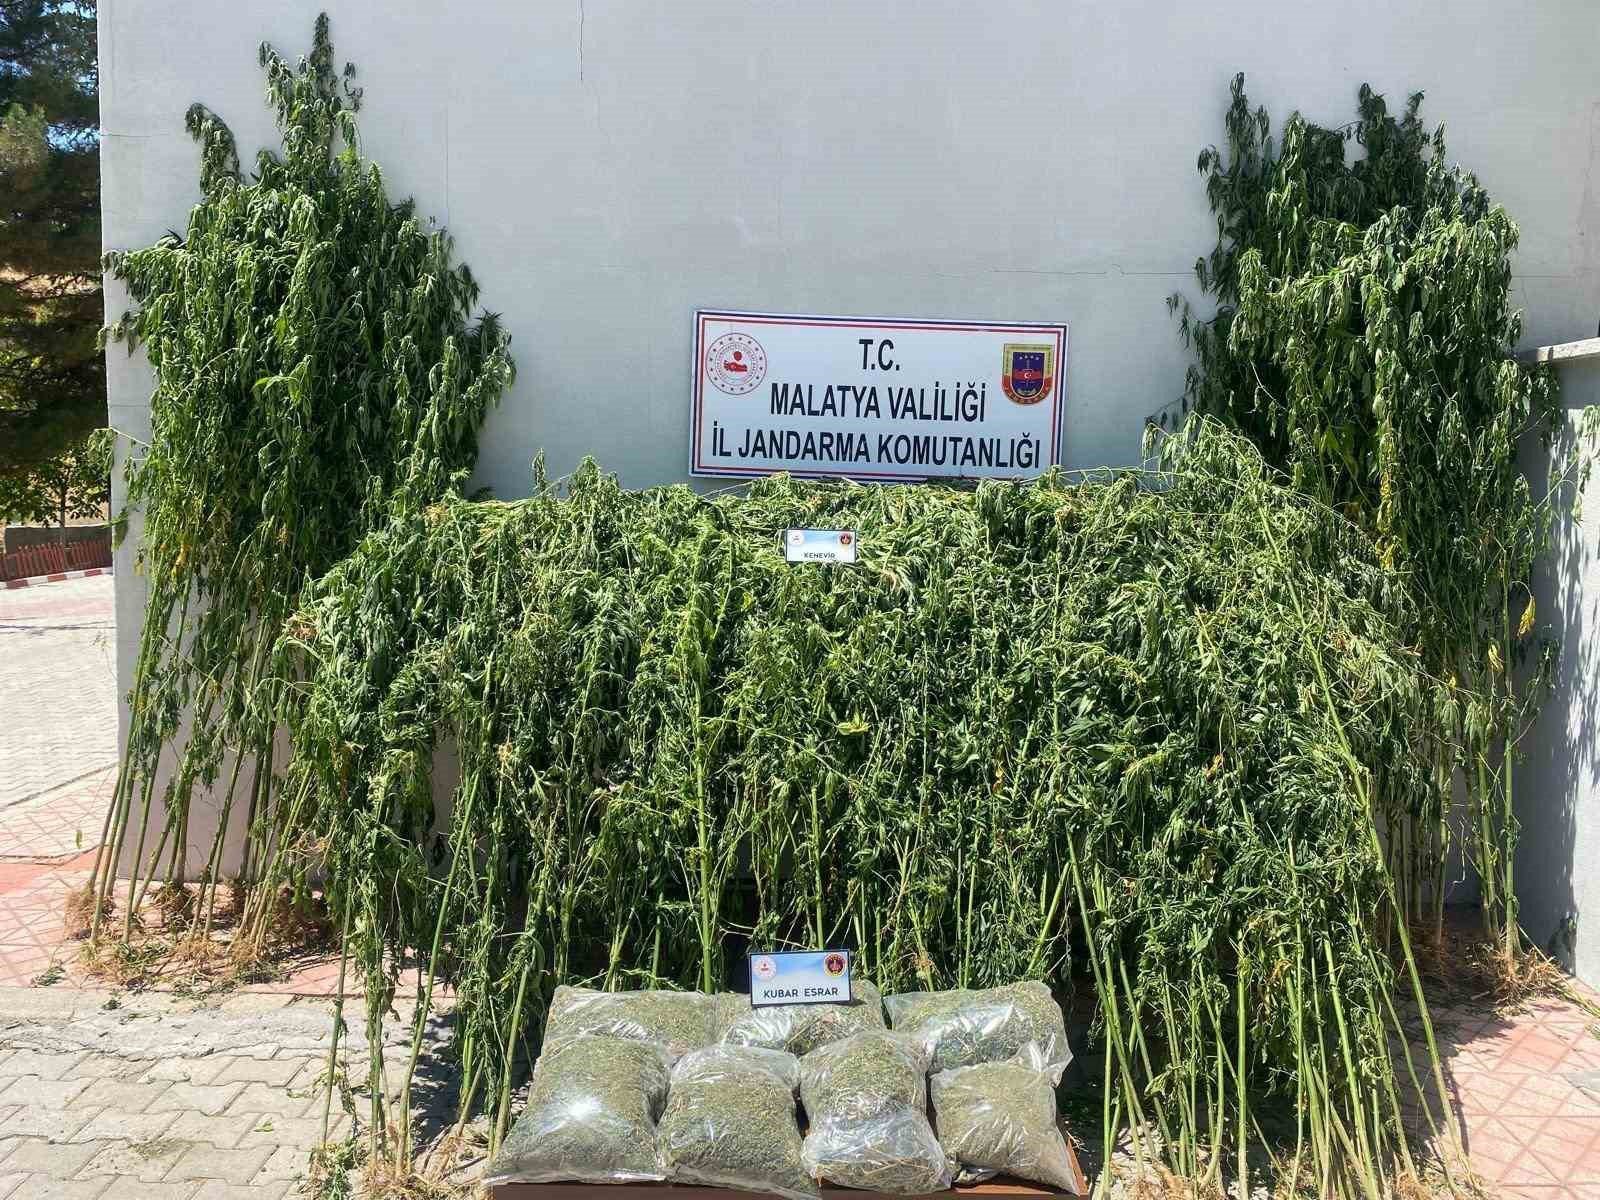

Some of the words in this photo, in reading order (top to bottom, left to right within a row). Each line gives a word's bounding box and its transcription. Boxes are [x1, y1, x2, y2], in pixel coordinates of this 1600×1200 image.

[859, 339, 900, 371] T.C.
[770, 383, 880, 419] MALATYA
[888, 381, 985, 422] VALİLİĞİ
[712, 421, 731, 457] İL
[738, 429, 870, 464] JANDARMA
[879, 432, 1040, 469] KOMUTANLIĞI
[763, 989, 798, 999] KUBAR
[804, 987, 838, 997] ESRAR
